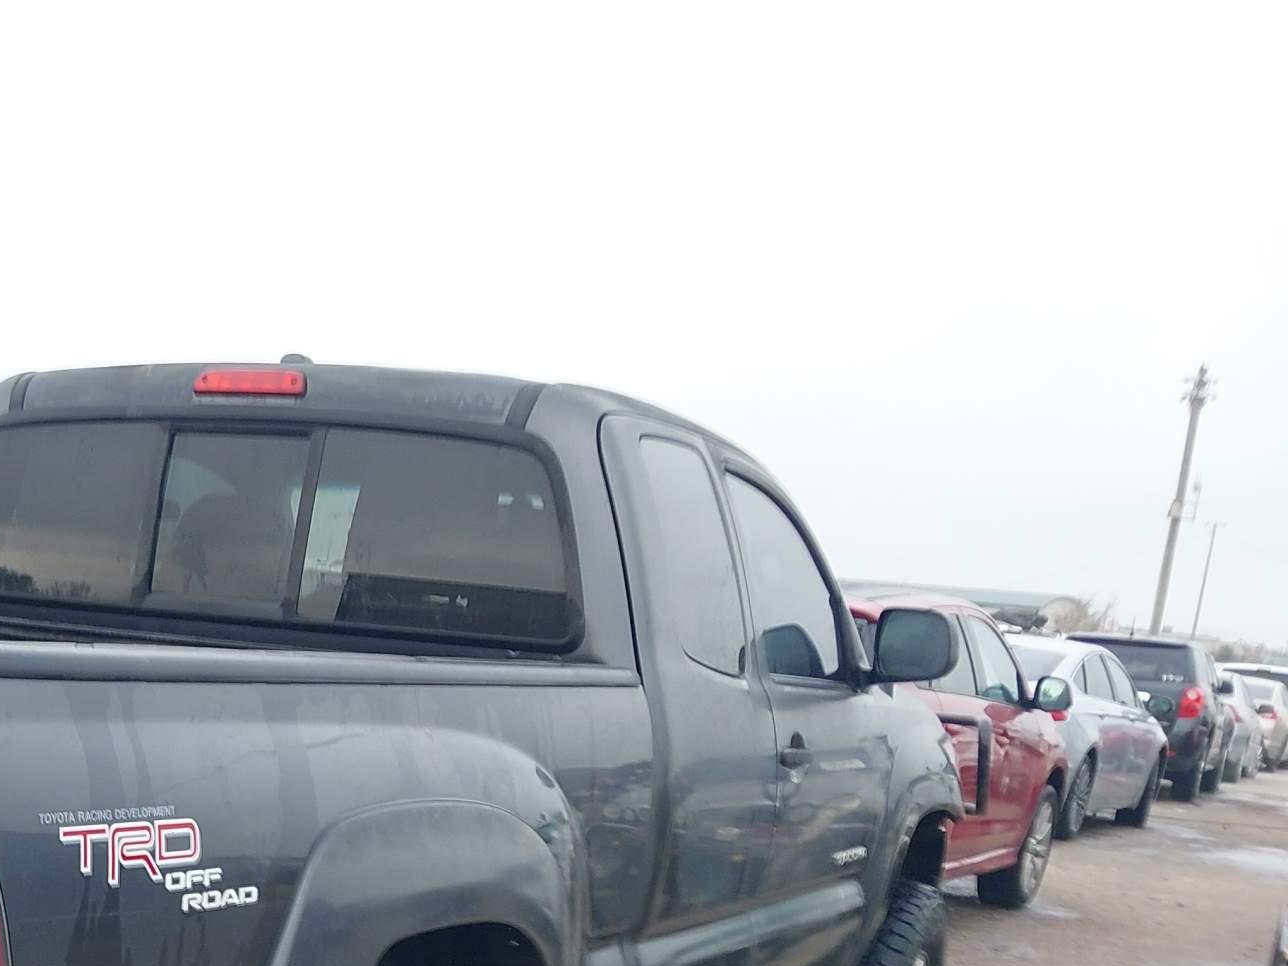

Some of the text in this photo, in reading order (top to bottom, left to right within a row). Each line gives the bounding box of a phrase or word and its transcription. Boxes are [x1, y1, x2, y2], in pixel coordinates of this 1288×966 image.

[38, 805, 176, 825] TOYOTA RACING DEVELOPMENT
[59, 818, 202, 888] TRD
[165, 867, 223, 892] OFF
[181, 886, 259, 913] ROAD
